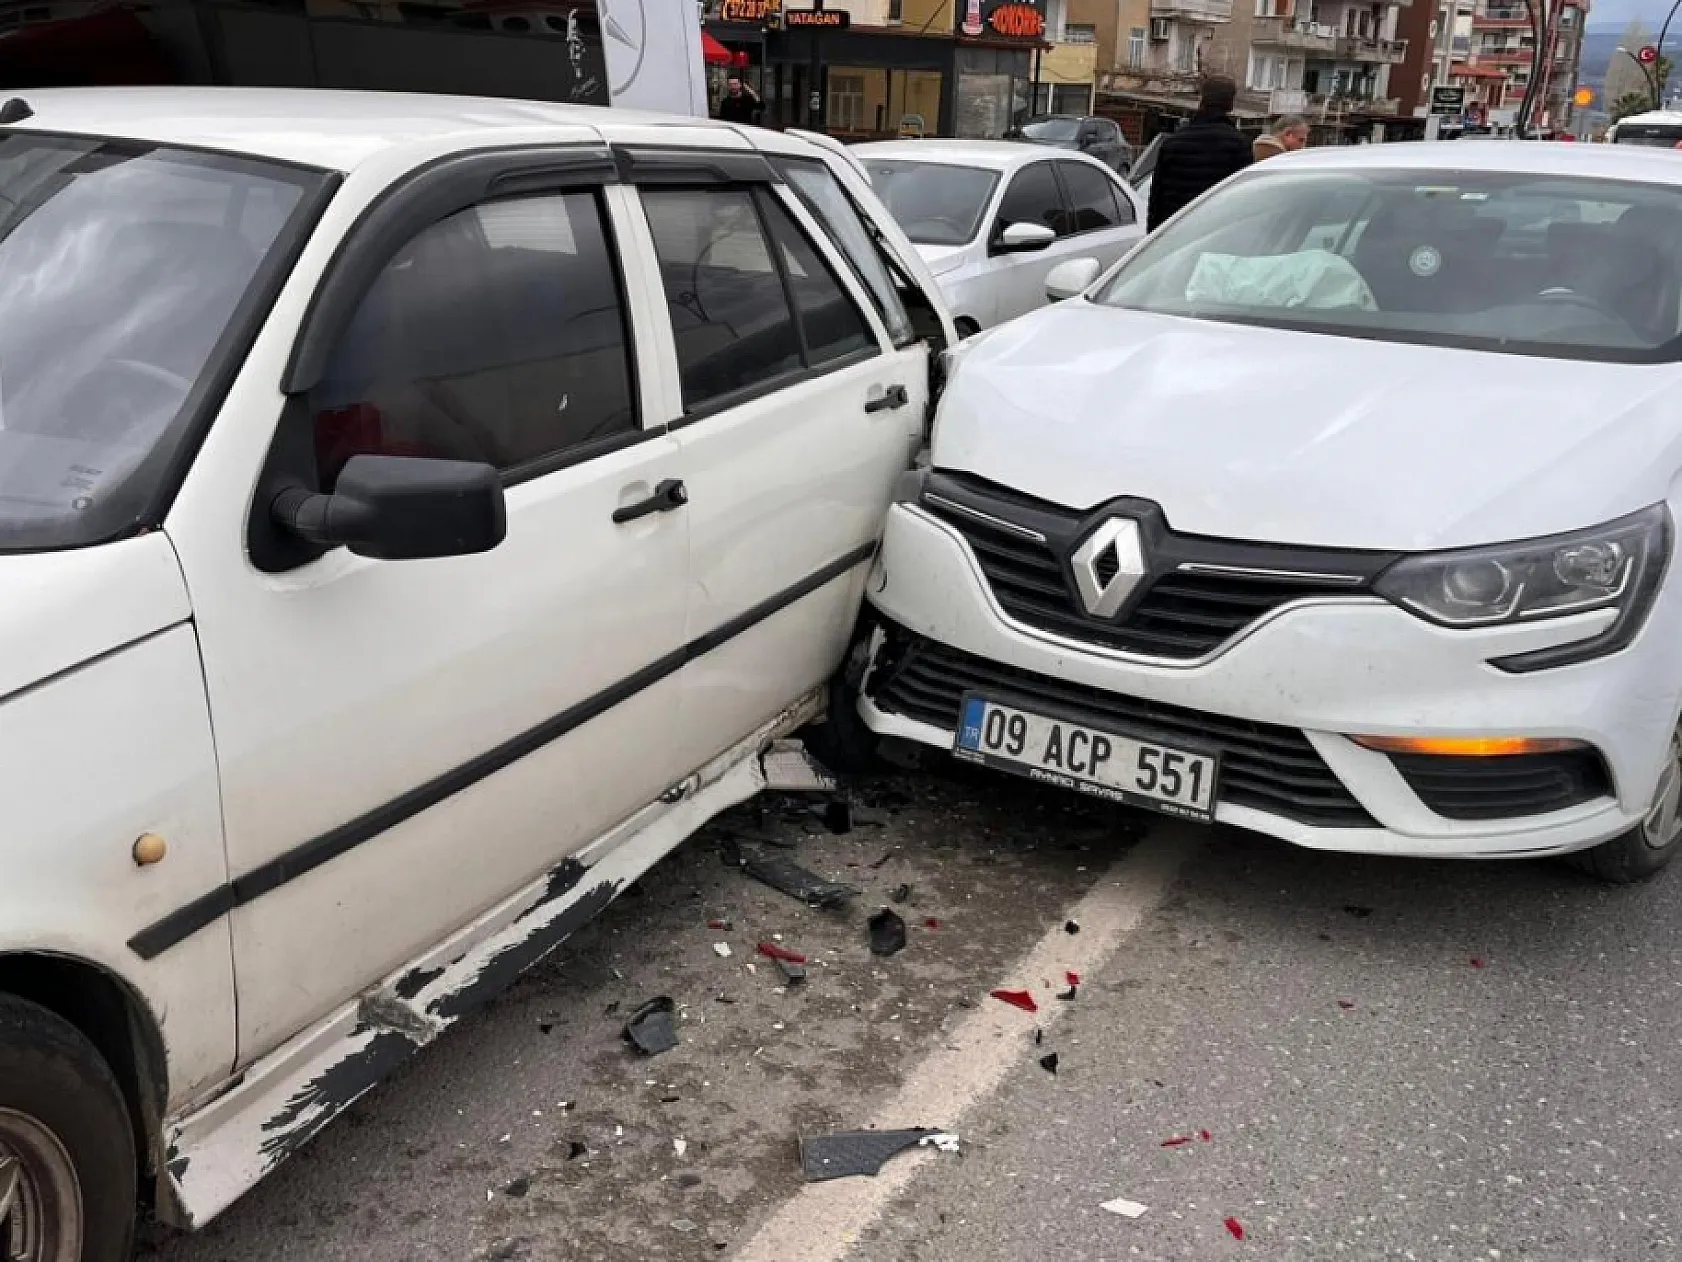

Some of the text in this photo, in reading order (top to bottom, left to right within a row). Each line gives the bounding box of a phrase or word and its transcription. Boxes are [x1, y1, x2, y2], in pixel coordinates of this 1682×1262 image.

[986, 709, 1026, 756] 09
[1042, 724, 1112, 777] ACP
[1136, 746, 1203, 802] 551
